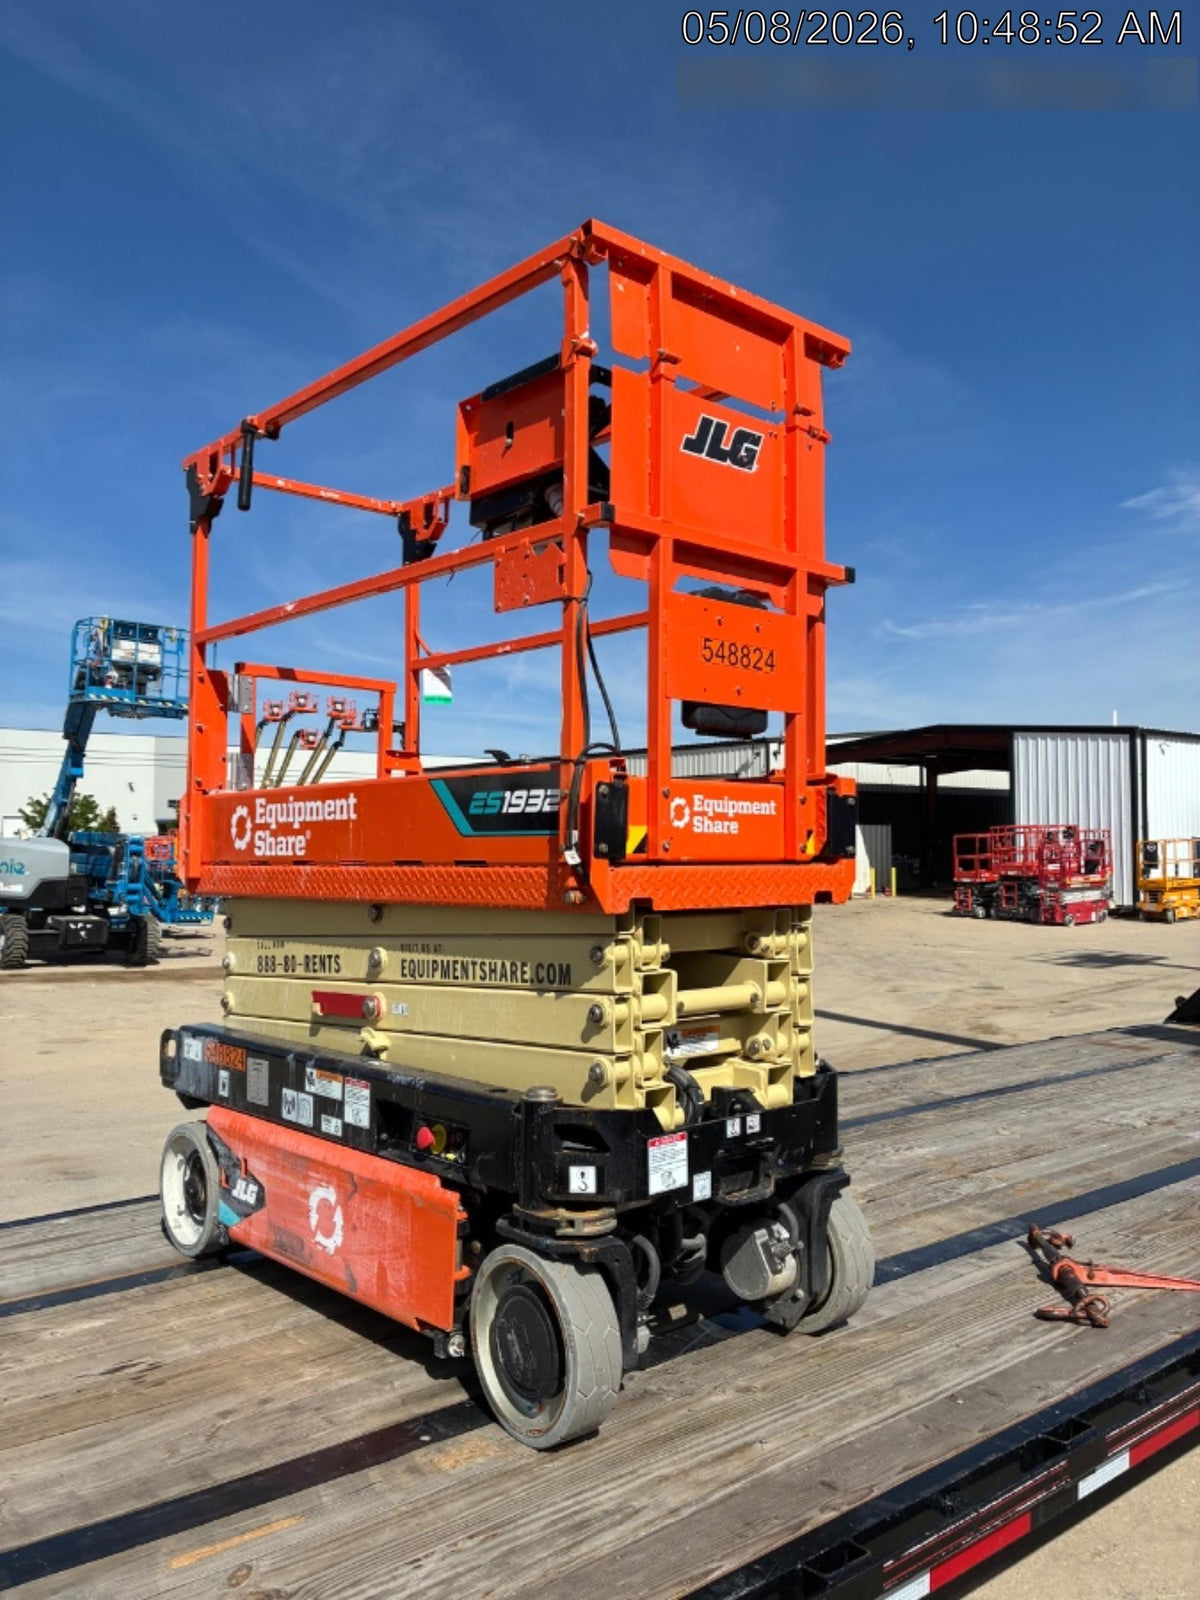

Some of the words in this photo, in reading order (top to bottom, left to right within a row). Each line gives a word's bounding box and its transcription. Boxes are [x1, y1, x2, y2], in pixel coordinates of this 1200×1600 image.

[680, 413, 765, 473] JLG
[702, 637, 776, 673] 548824
[255, 792, 358, 829] Equipment
[469, 789, 561, 815] ES1932
[693, 794, 776, 817] Equipment
[693, 815, 739, 834] Share
[400, 958, 572, 986] EQUIPMENTSHARE.COM
[231, 1179, 258, 1205] JLG
